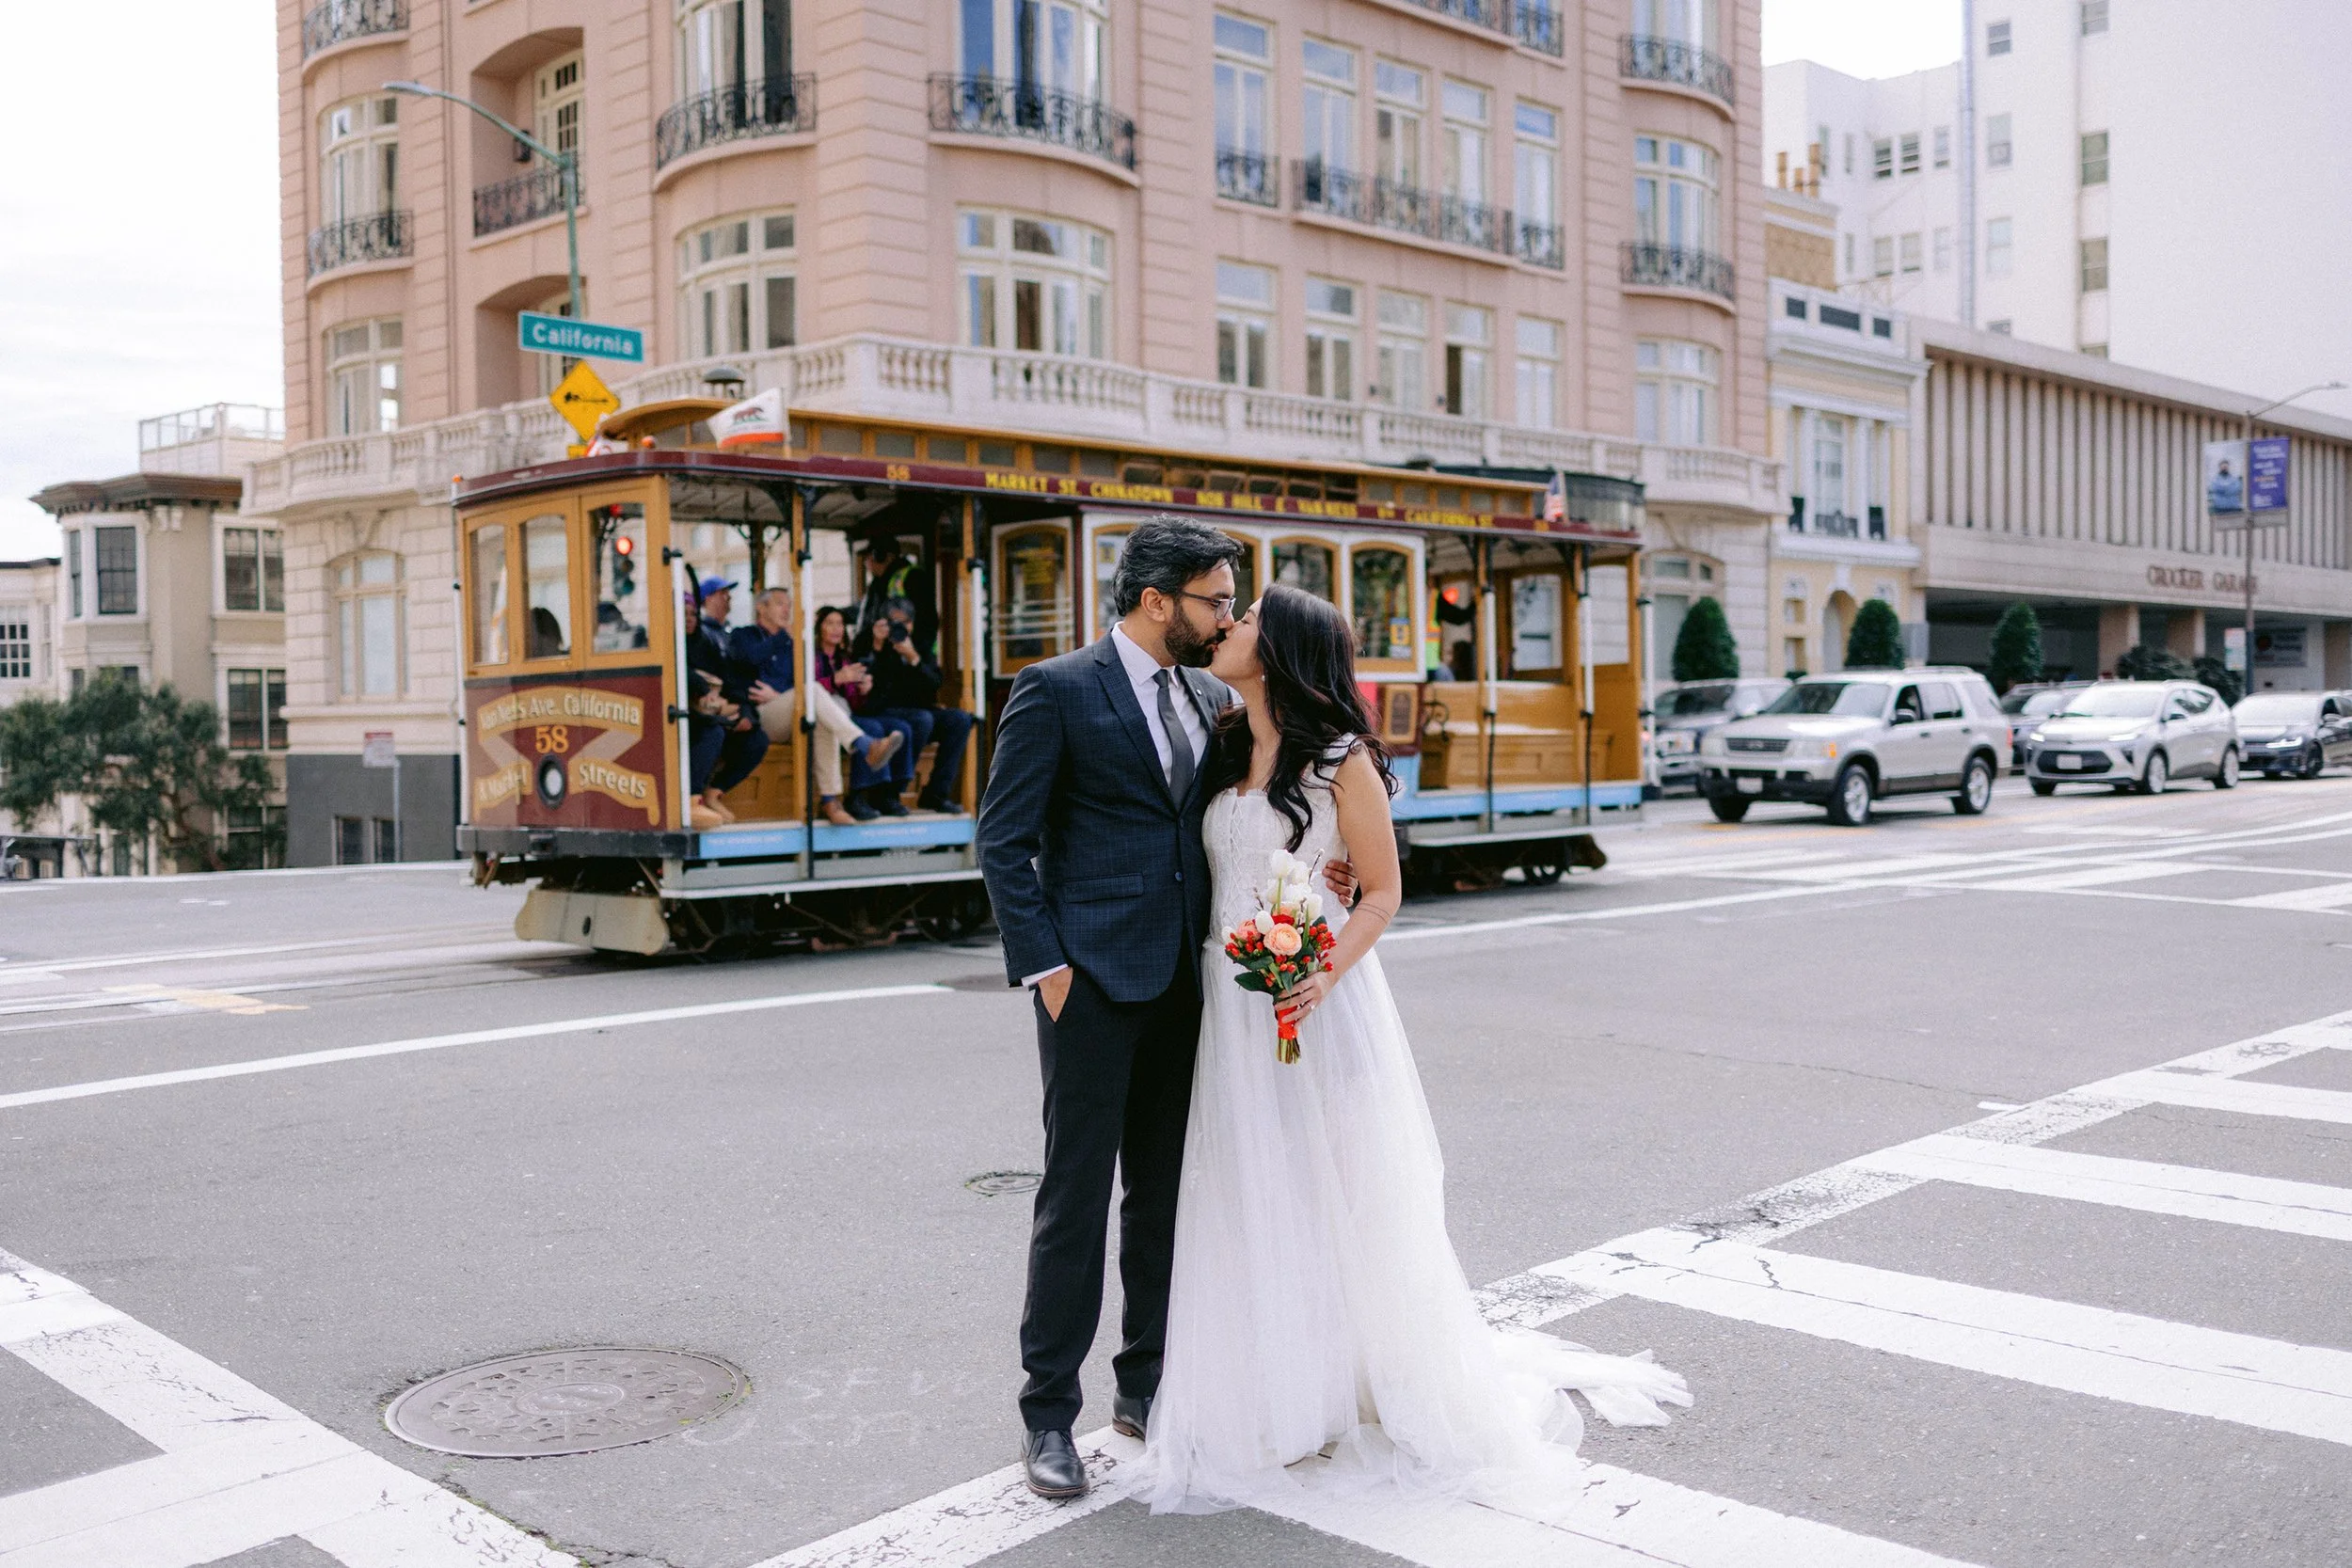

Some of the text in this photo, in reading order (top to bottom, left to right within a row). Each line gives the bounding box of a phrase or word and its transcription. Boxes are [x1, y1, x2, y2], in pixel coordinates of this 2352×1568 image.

[532, 322, 634, 356] California
[985, 471, 1048, 493] MARKET
[1089, 482, 1173, 503] CHINATOWN
[1232, 493, 1263, 511] HILL
[2213, 571, 2258, 594] GARAE
[564, 692, 641, 725] California
[535, 725, 569, 753] 58
[580, 763, 648, 799] Streets
